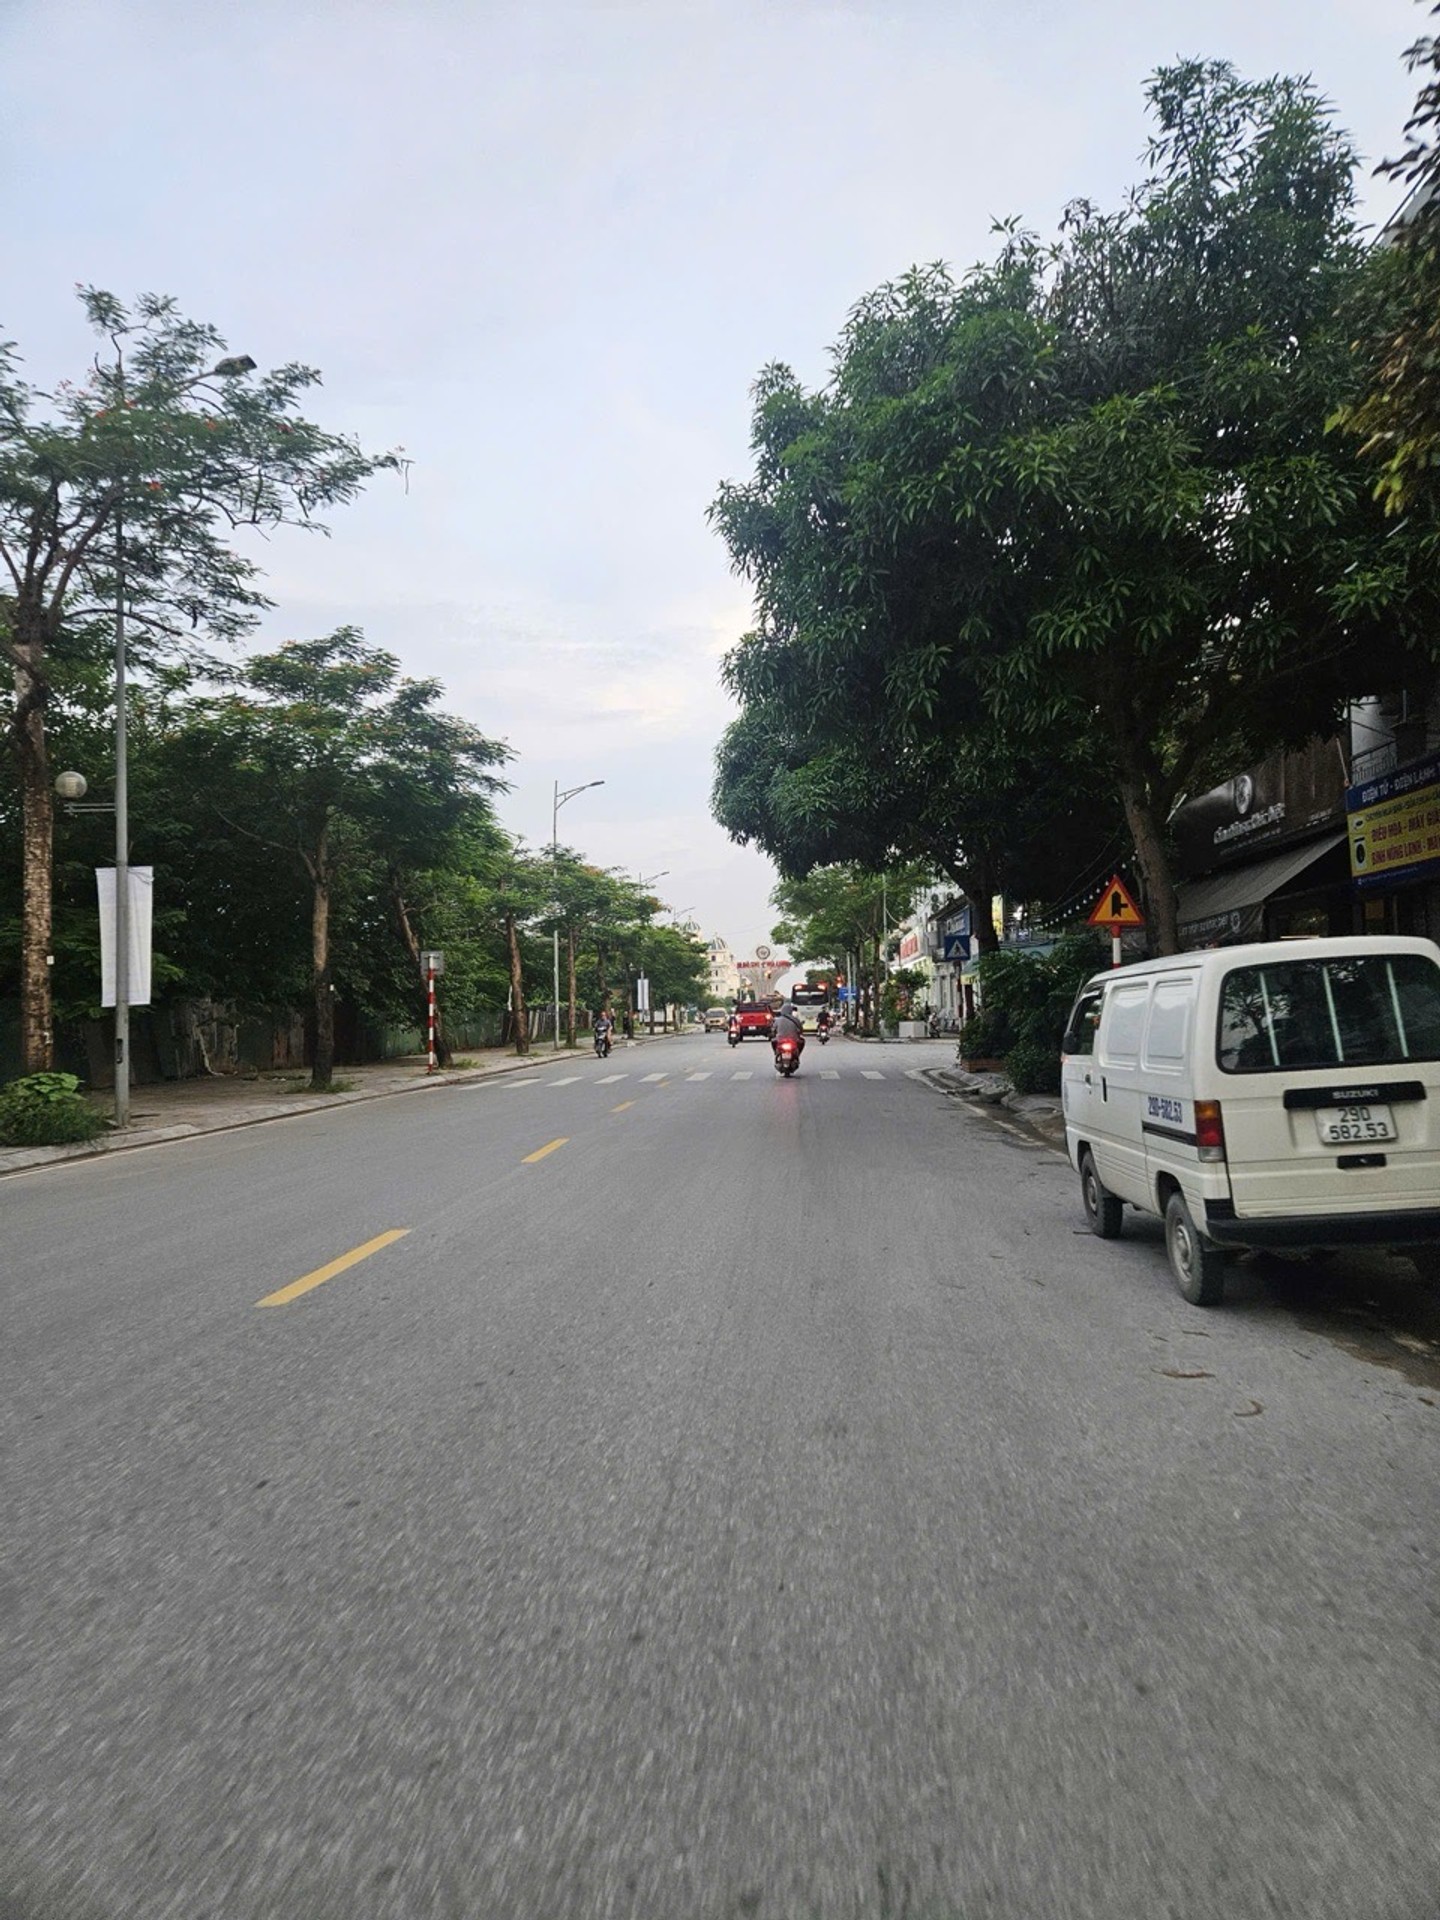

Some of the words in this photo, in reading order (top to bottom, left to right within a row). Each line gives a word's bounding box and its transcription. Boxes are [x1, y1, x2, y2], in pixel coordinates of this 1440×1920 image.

[1332, 1089, 1379, 1099] SUZUKI
[1338, 1106, 1371, 1123] 29D
[1330, 1122, 1389, 1141] 582.53
